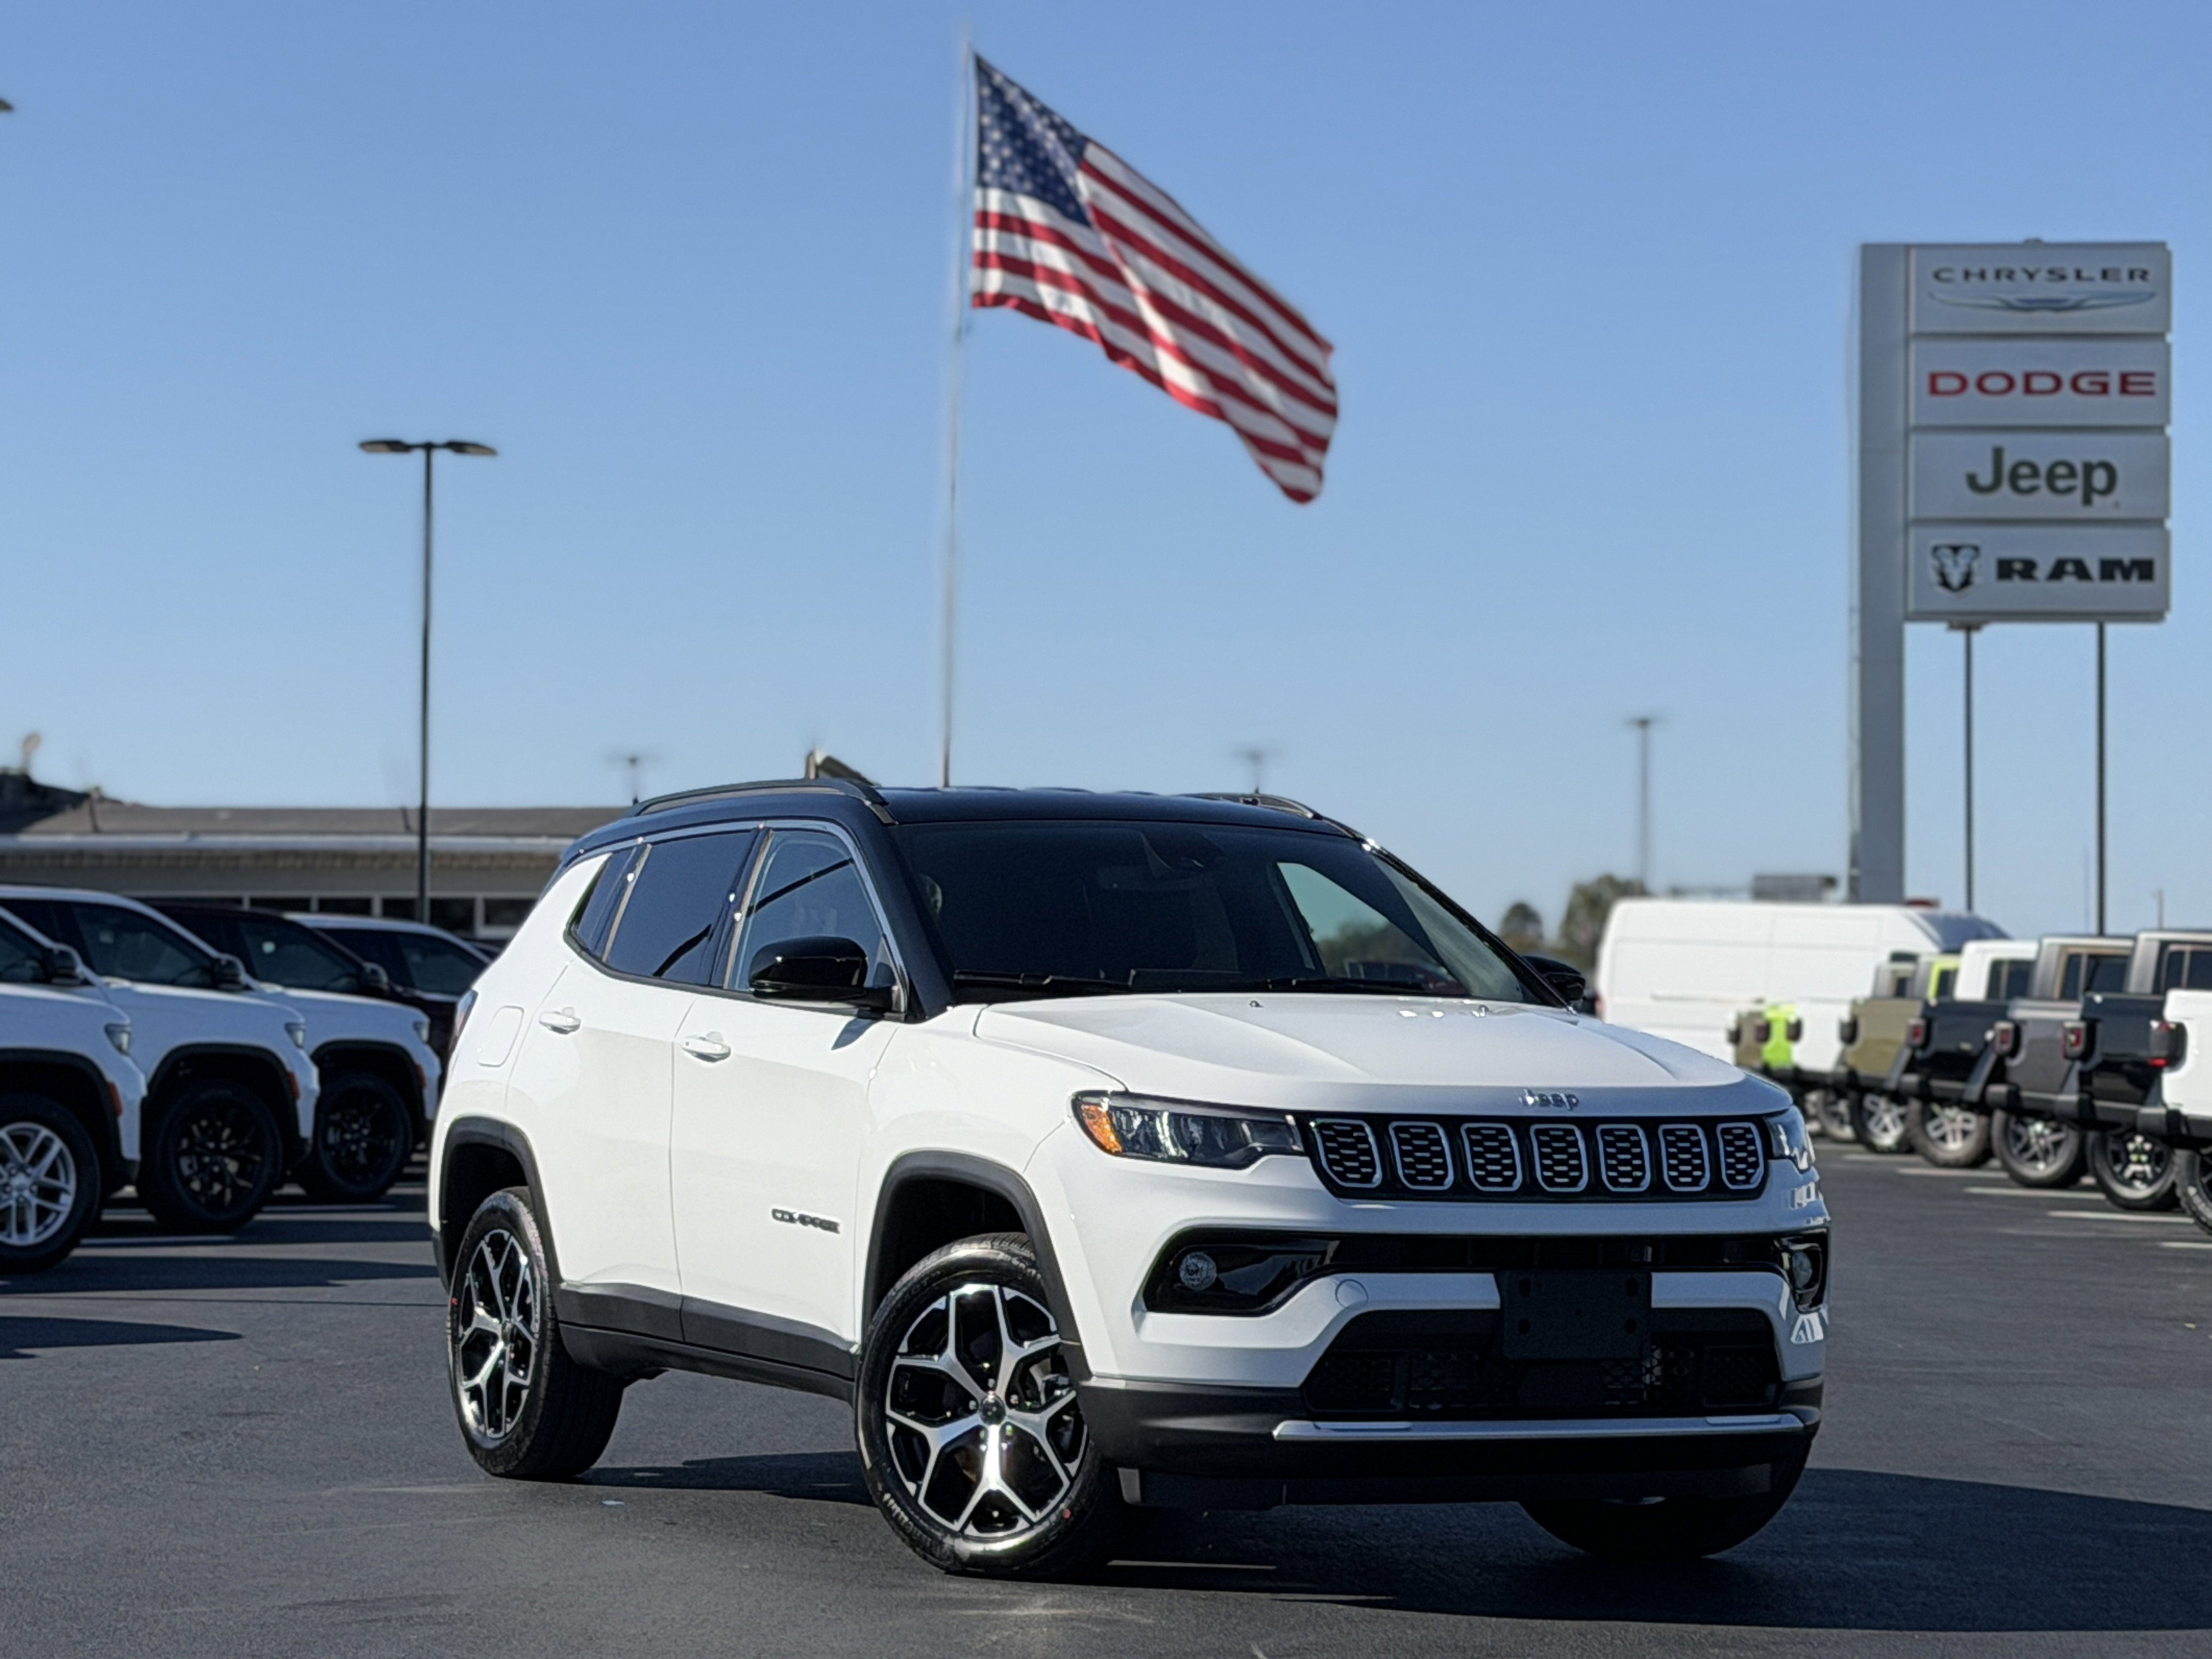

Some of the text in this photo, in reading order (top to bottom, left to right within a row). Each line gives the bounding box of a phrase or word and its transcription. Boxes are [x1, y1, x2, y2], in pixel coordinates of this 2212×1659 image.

[1932, 267, 2150, 283] CHRYSLER
[1927, 371, 2156, 397] DODGE
[1965, 445, 2118, 507] Jeep
[1995, 557, 2156, 583] RAM
[1518, 1088, 1579, 1111] Jeep
